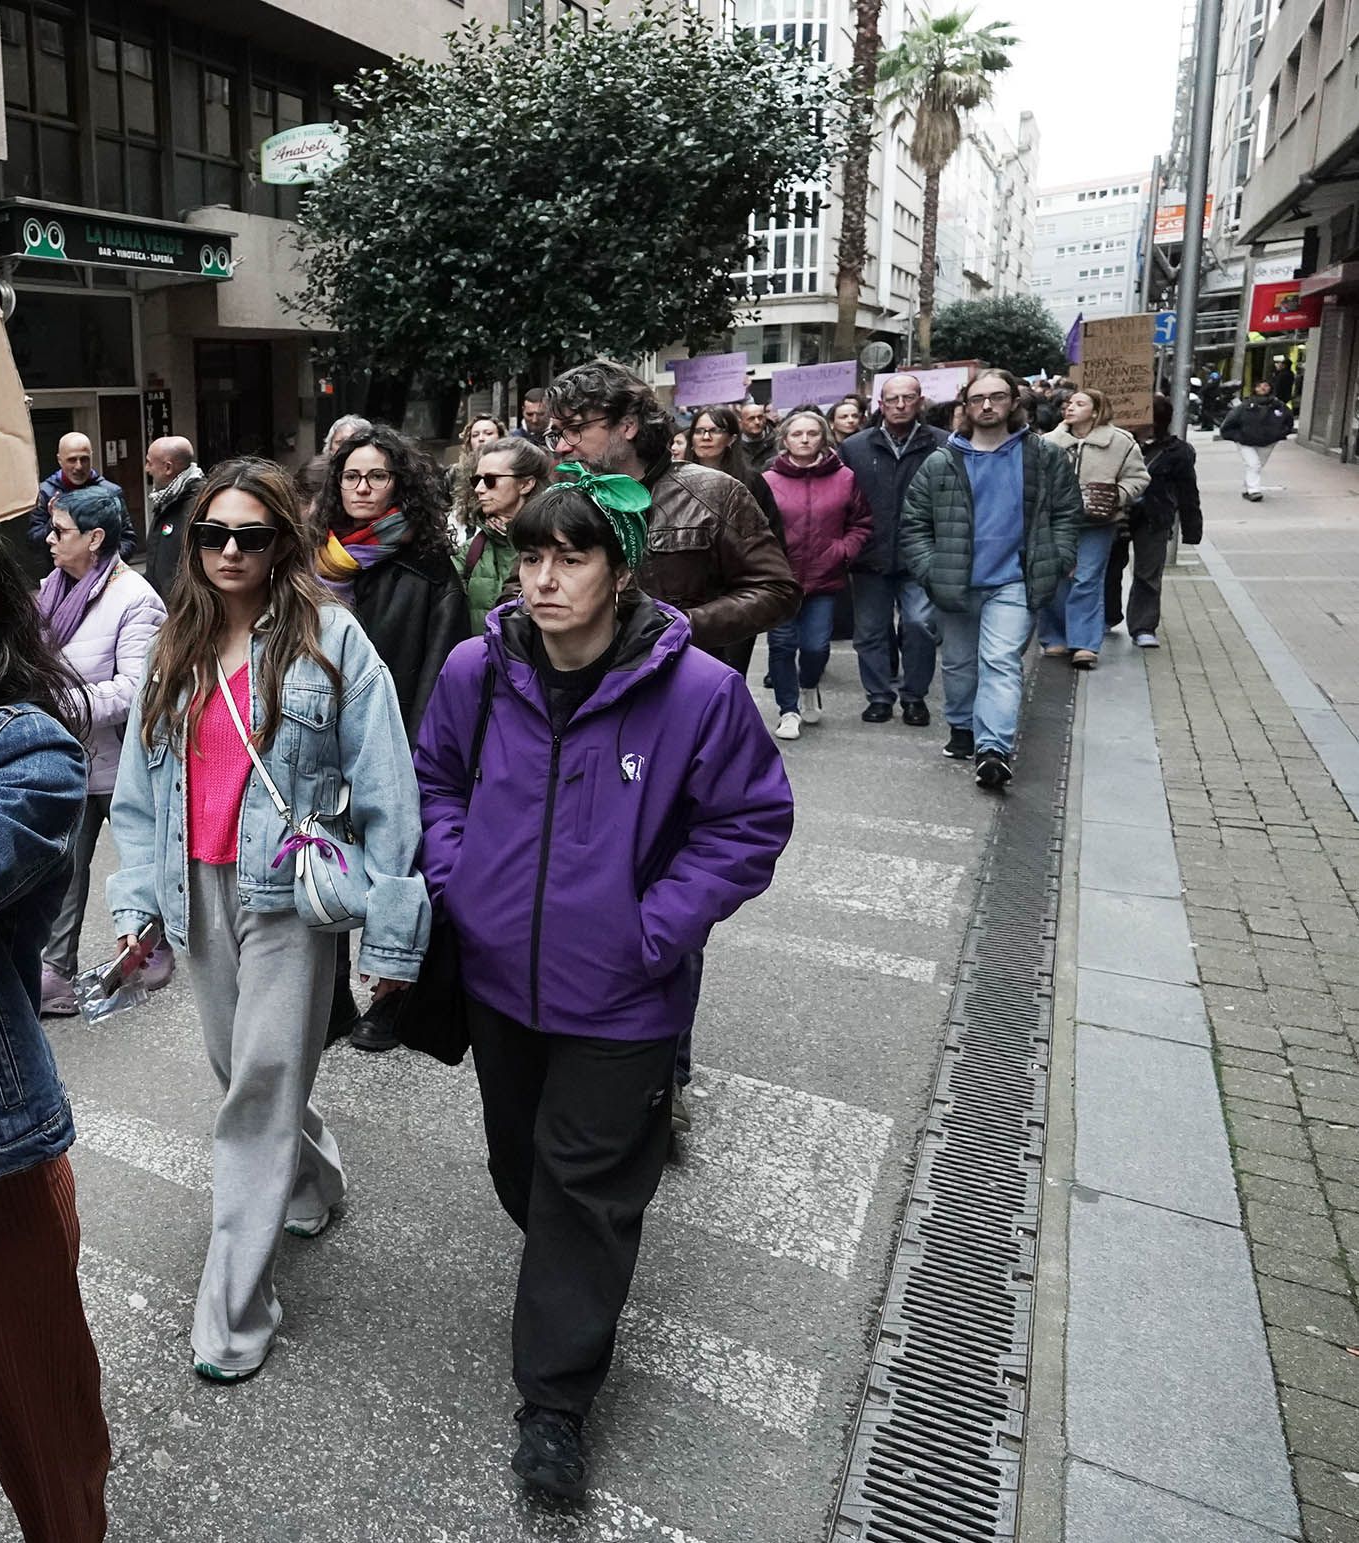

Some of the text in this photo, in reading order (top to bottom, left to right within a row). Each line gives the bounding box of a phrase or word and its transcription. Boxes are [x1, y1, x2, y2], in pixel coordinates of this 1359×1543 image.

[85, 223, 185, 256] LA RANA VERDE
[98, 246, 111, 257] BAR
[115, 249, 147, 261] VINOTECA
